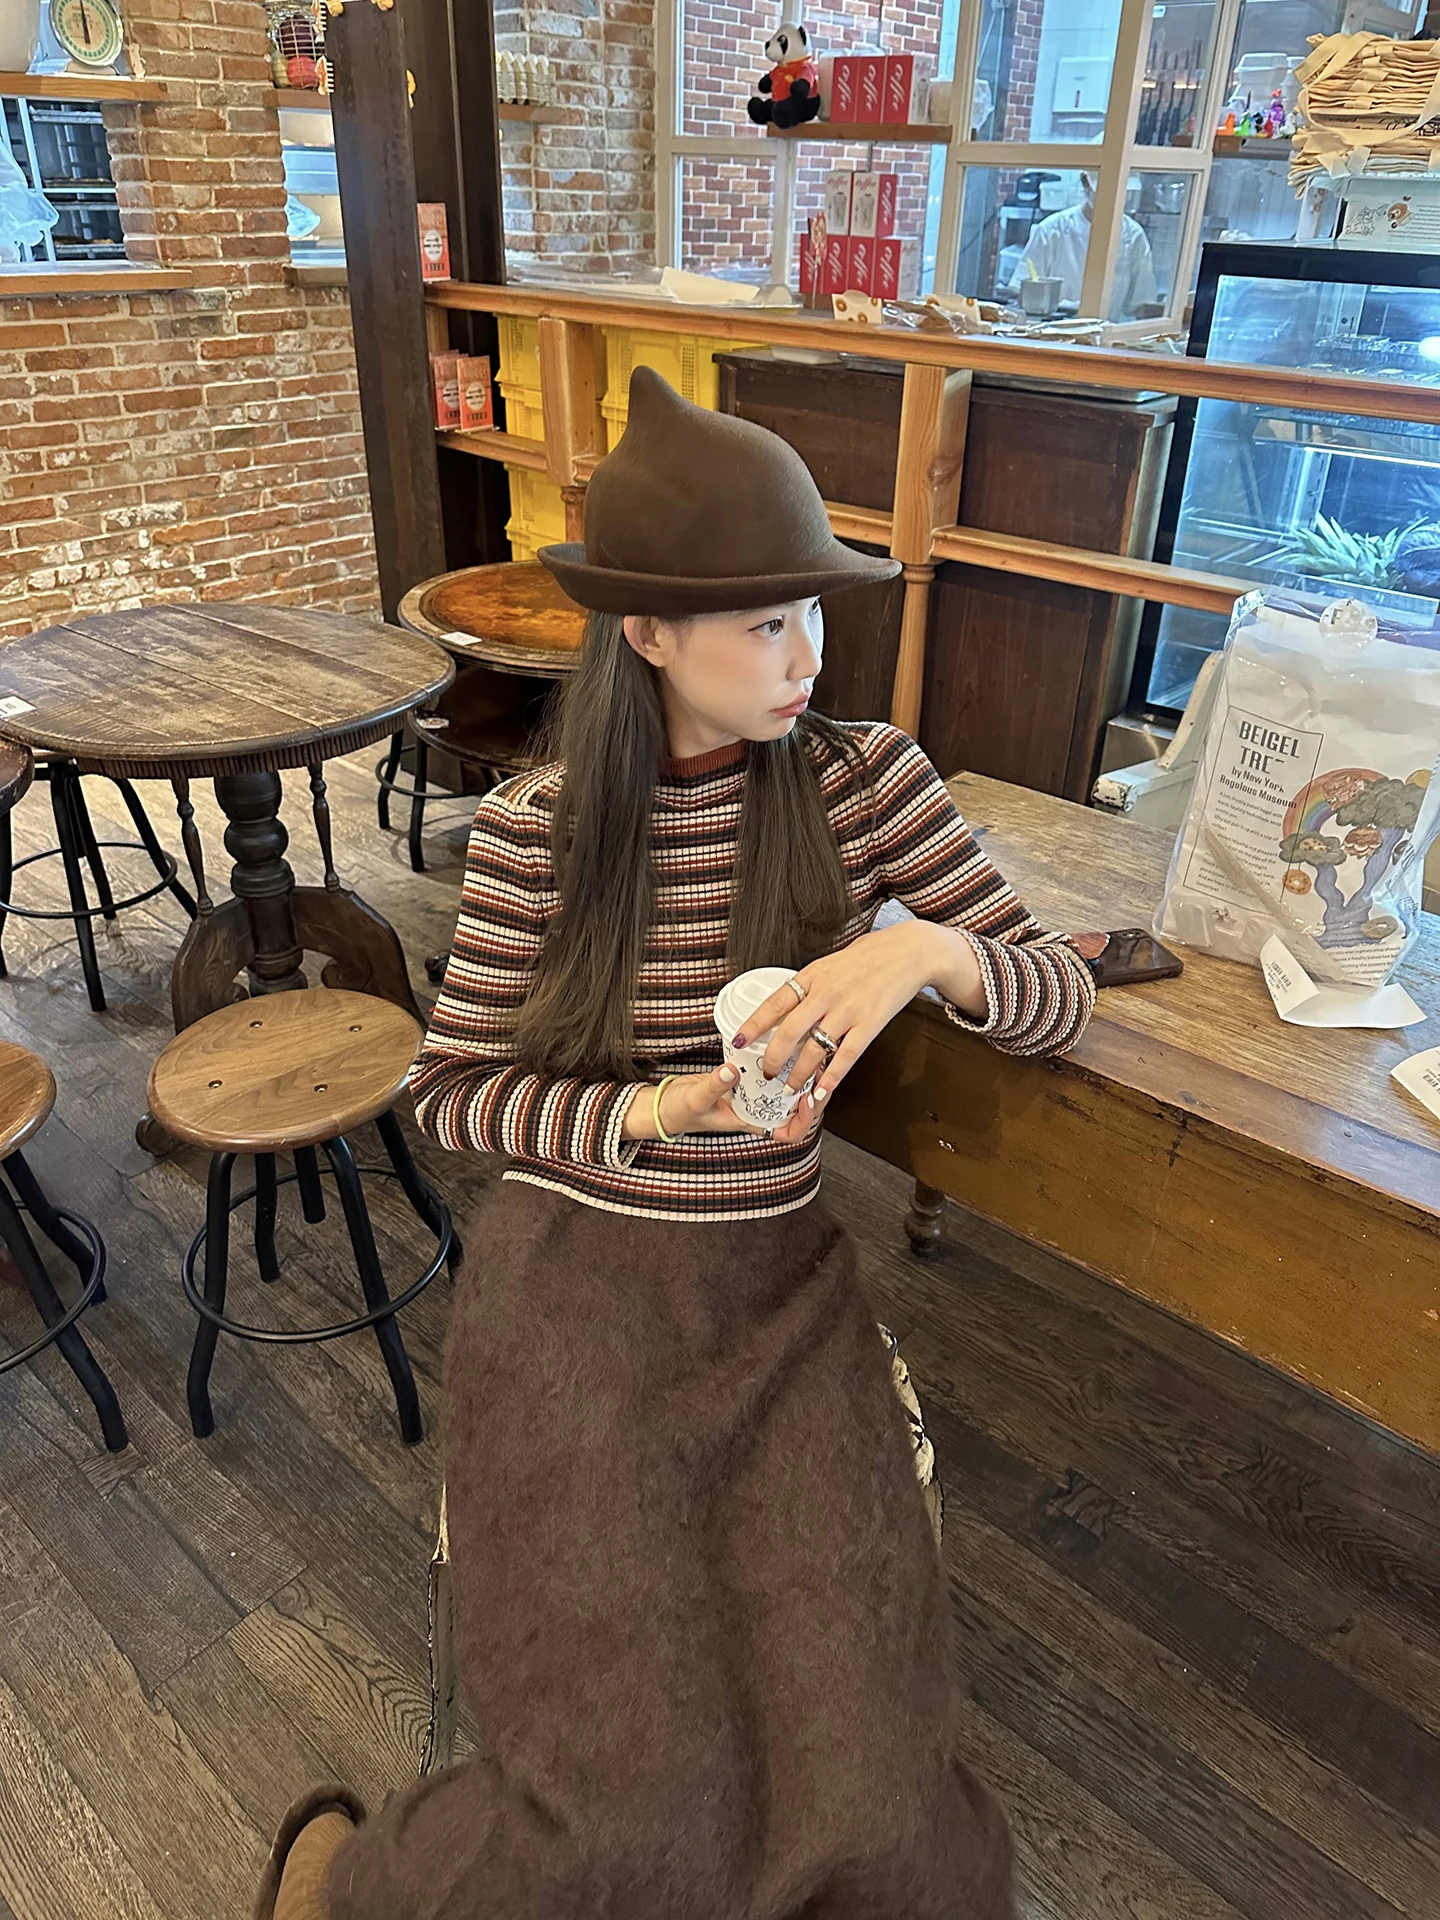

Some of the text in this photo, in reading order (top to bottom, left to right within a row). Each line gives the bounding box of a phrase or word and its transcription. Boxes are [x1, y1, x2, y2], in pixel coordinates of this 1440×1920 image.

[1238, 720, 1300, 759] BEIGEL
[1231, 766, 1242, 779] by
[1240, 745, 1285, 775] TRE
